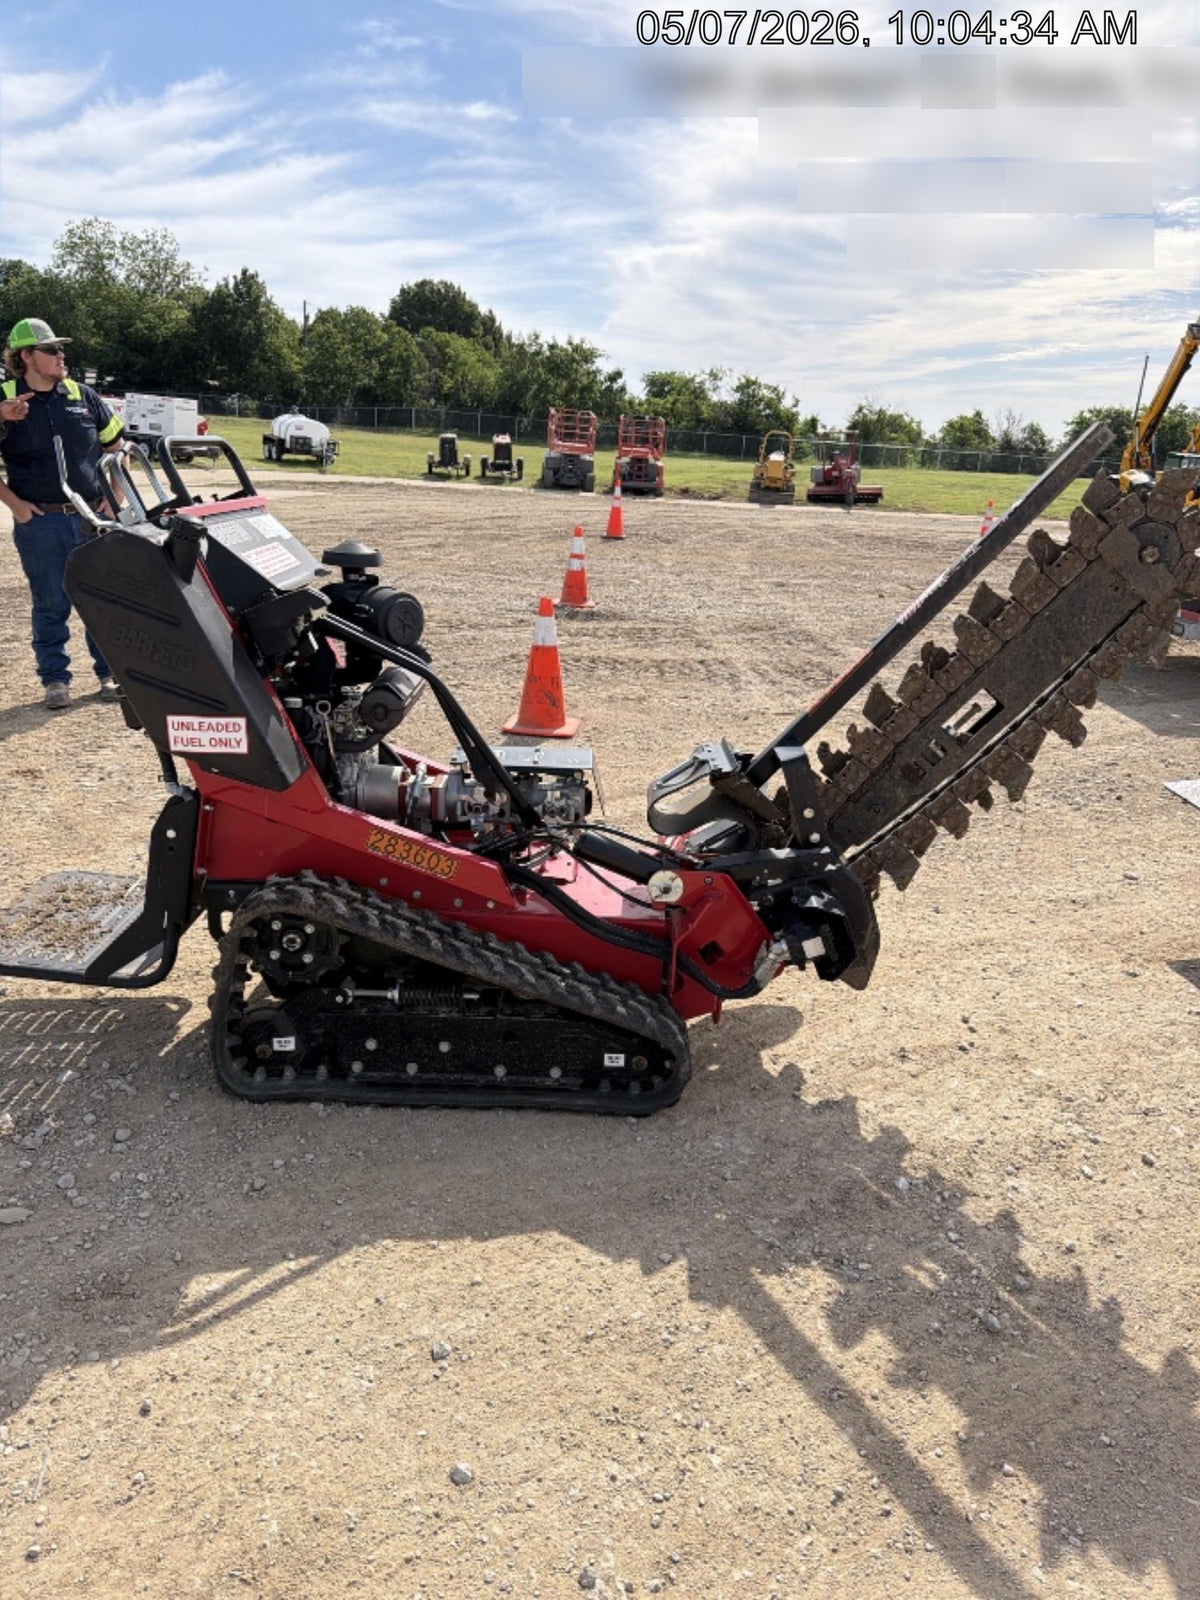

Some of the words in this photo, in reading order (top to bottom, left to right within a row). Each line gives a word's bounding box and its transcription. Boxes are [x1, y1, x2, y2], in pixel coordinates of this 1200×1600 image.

[171, 721, 242, 733] UNLEADED
[173, 736, 206, 748] FUEL
[209, 737, 242, 749] ONLY
[366, 827, 455, 877] 283603
